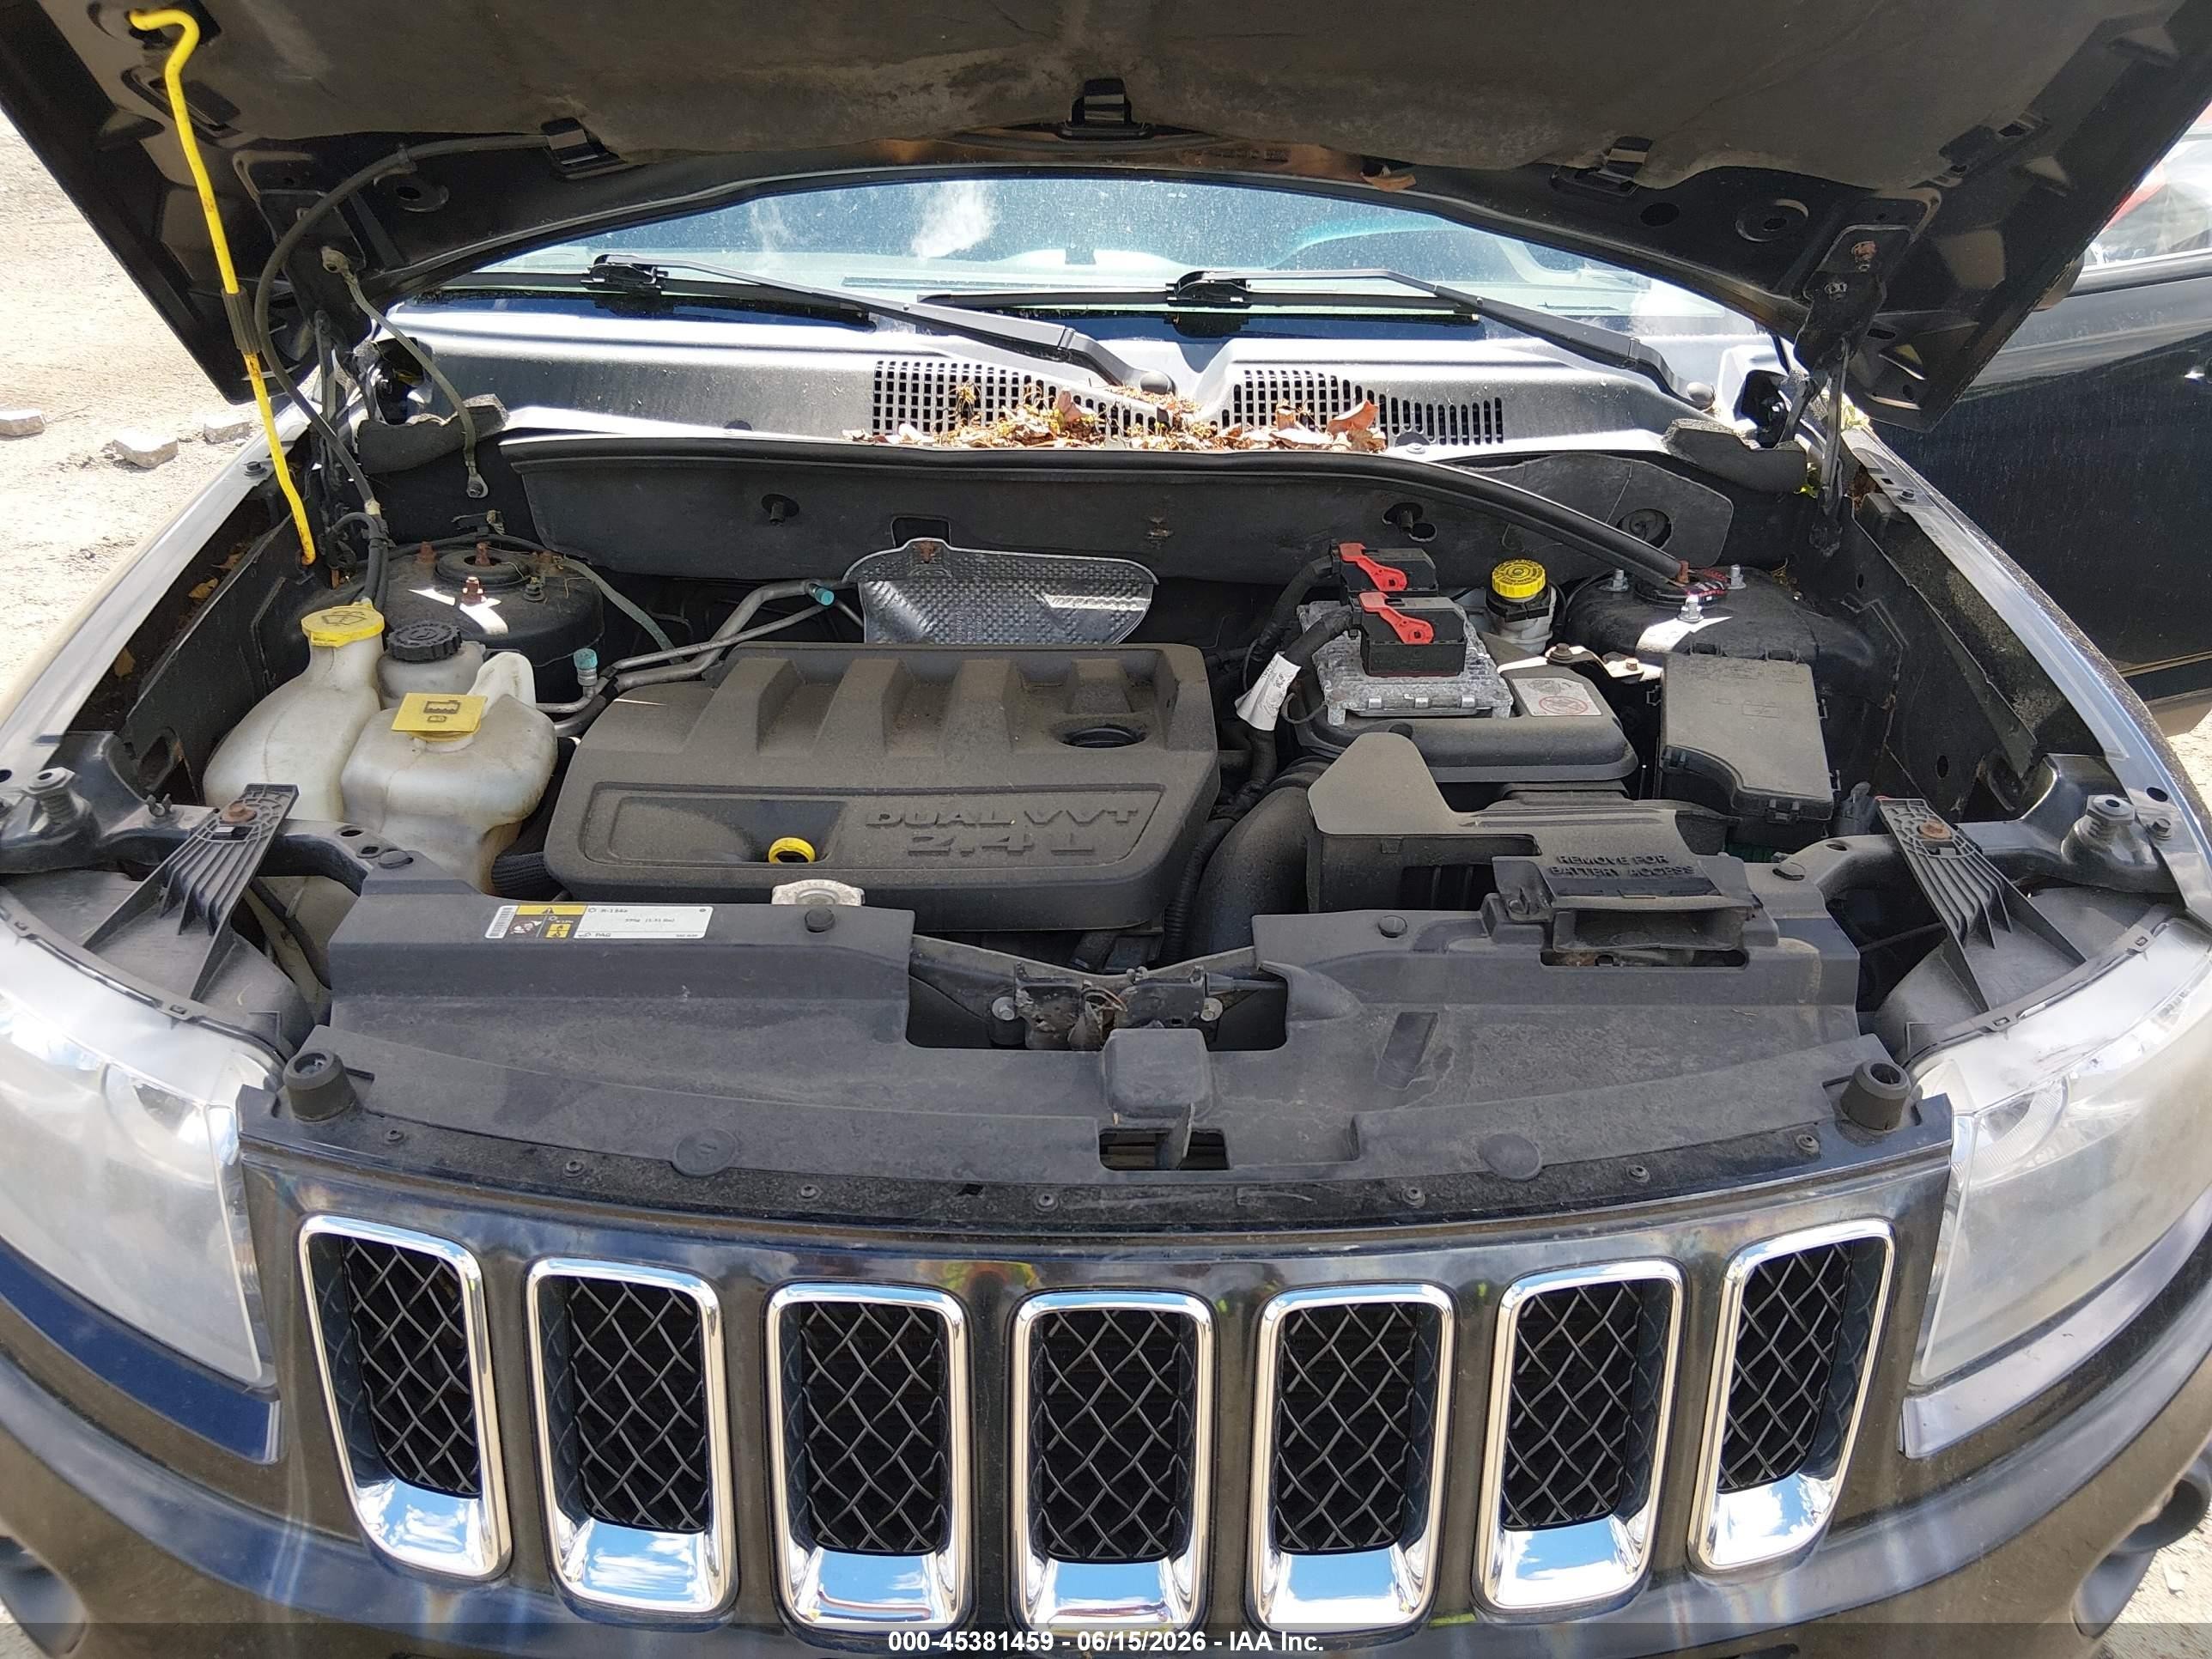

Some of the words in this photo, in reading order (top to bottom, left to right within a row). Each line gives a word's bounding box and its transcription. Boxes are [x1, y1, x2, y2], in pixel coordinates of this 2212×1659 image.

[866, 810, 1015, 828] DUAL
[1023, 809, 1139, 826] VVT
[1557, 855, 1631, 866] REMOVE
[1632, 854, 1669, 865] FOR
[1549, 866, 1620, 877] BATTERY
[1630, 866, 1696, 877] ACCESS
